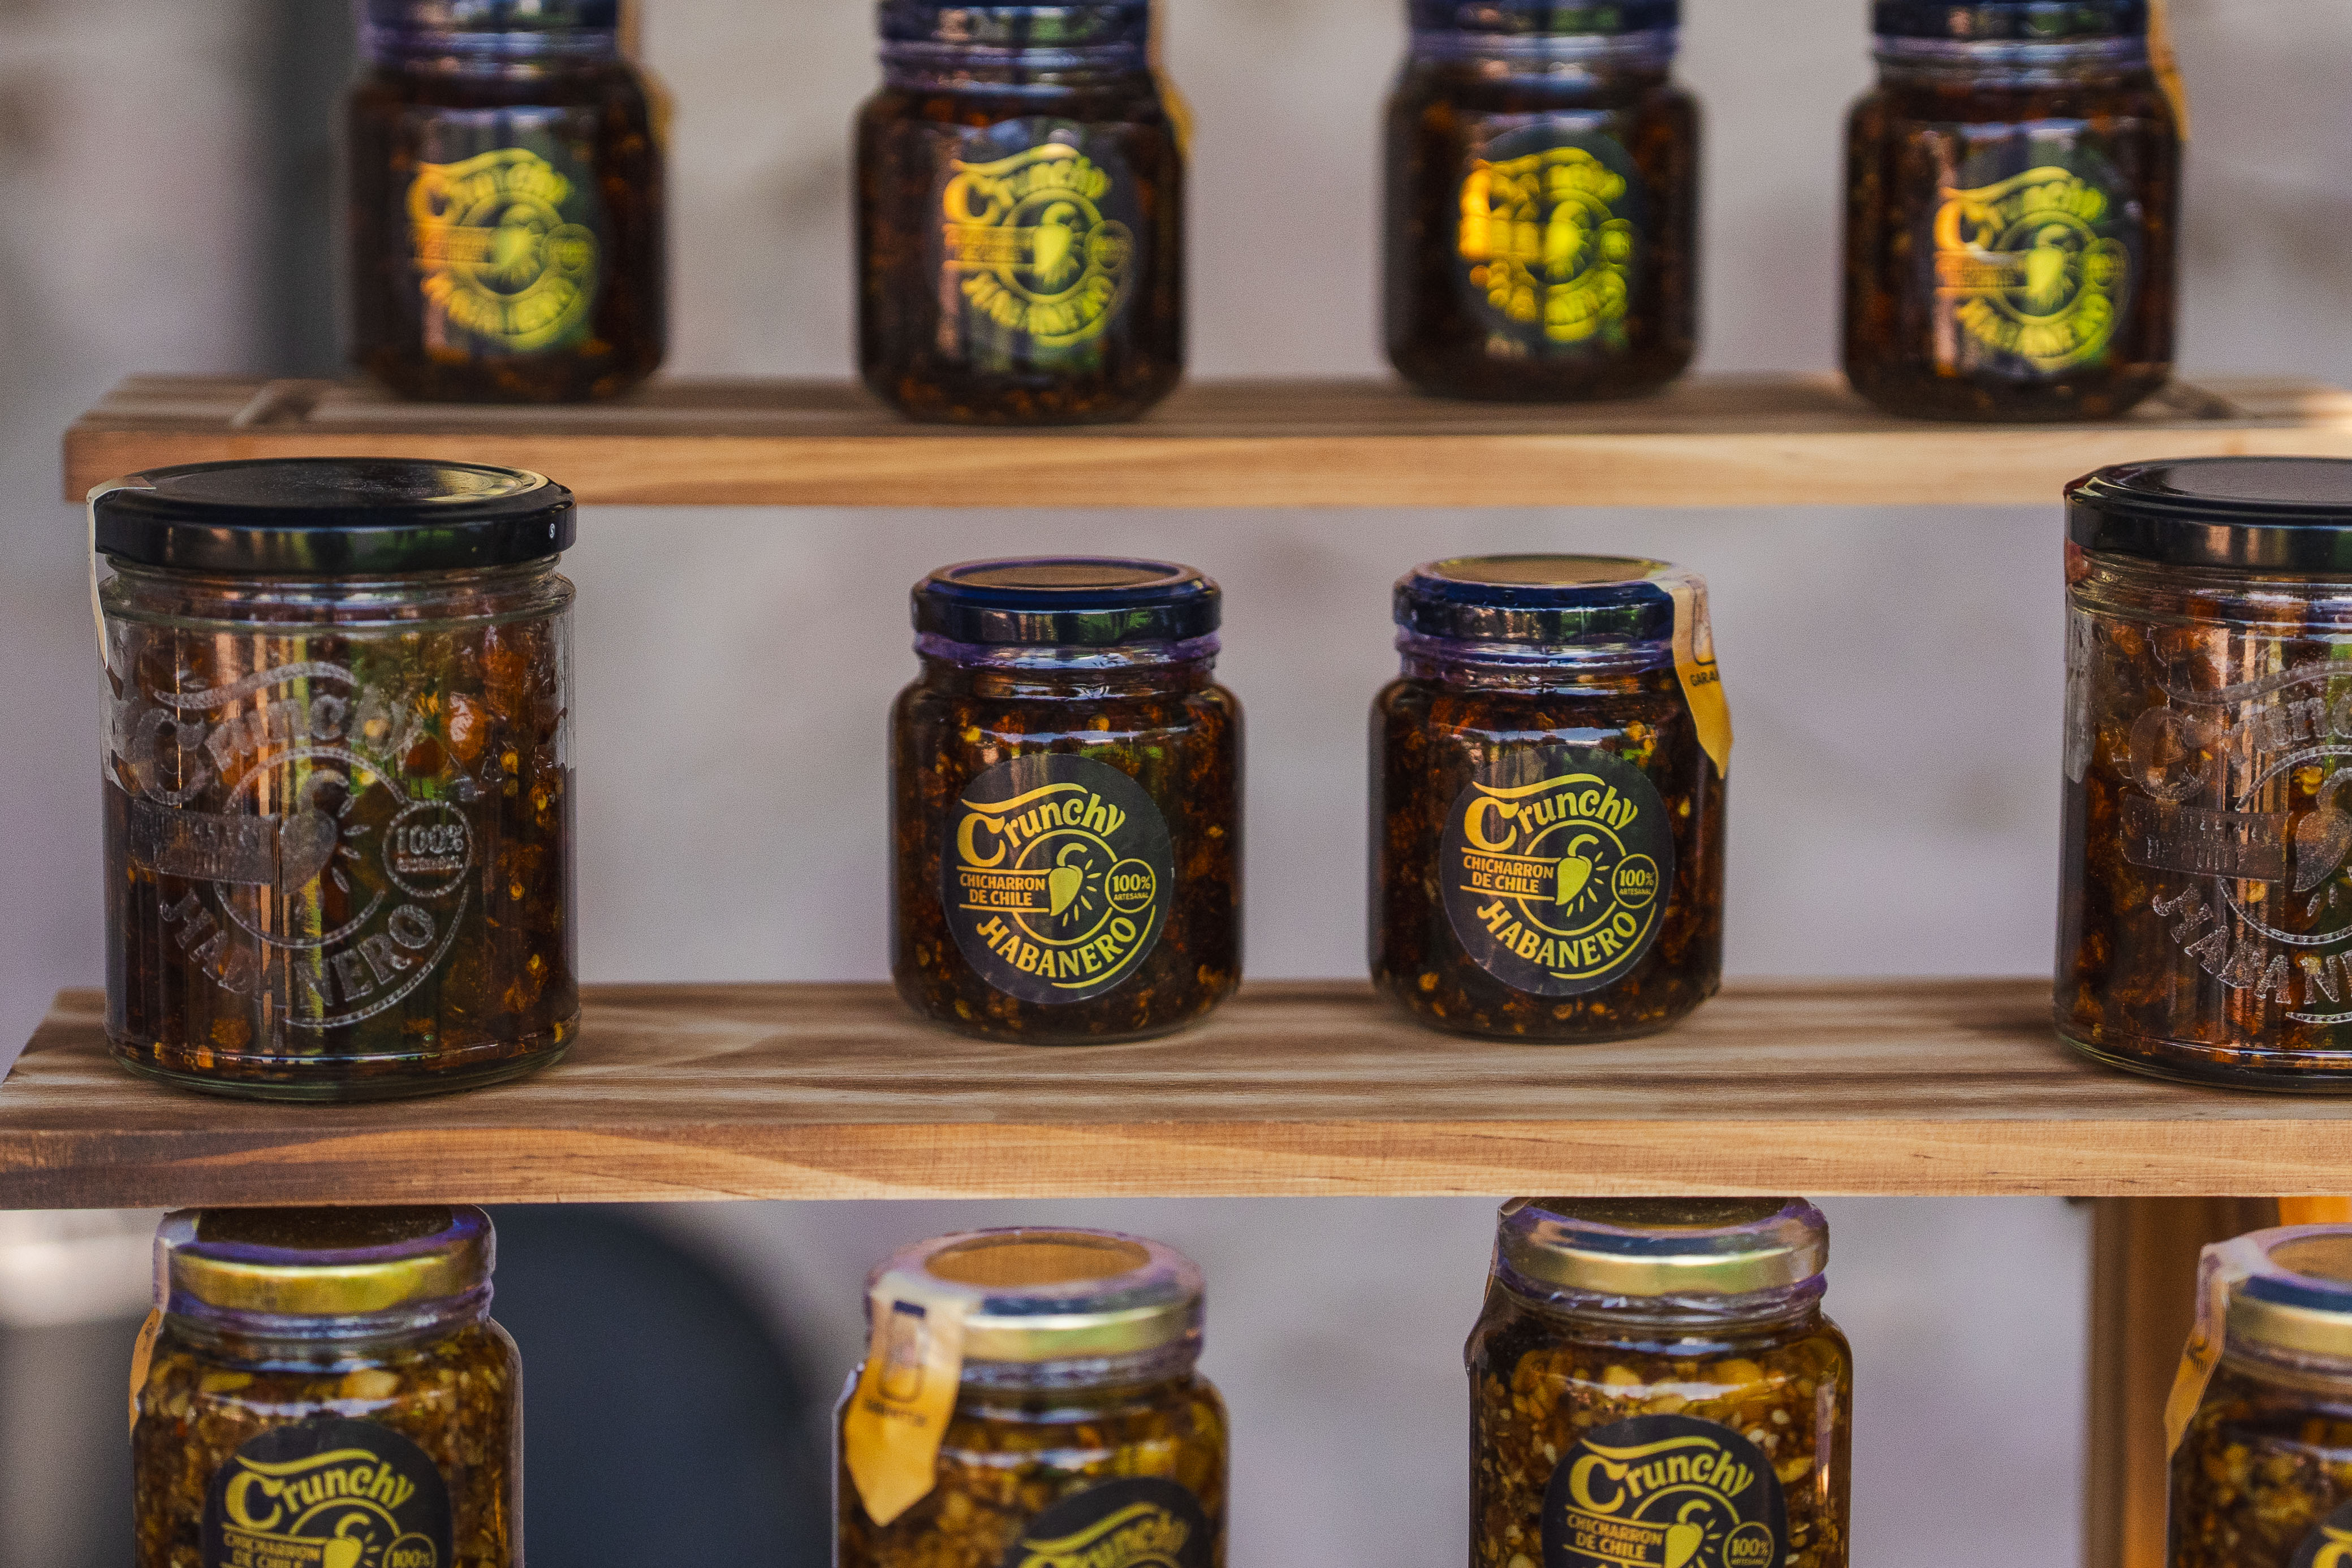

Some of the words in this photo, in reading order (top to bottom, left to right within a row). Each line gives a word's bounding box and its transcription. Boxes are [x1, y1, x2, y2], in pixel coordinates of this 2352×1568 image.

[957, 783, 1125, 867] Crunchy
[1464, 773, 1638, 852] Crunchy
[397, 824, 464, 854] 100%
[960, 873, 1046, 891] CHICHARRON
[1463, 855, 1554, 879] CHICHARRON
[1471, 871, 1492, 888] DE
[1495, 875, 1539, 893] CHILE
[1620, 869, 1655, 887] 100%
[969, 888, 987, 904] DE
[990, 890, 1033, 906] CHILE
[1112, 874, 1151, 892] 100%
[977, 915, 1136, 978] HABANERO
[1477, 900, 1637, 969] HABANERO
[226, 1448, 415, 1530] Crunchy
[1569, 1436, 1754, 1514] Crunchy
